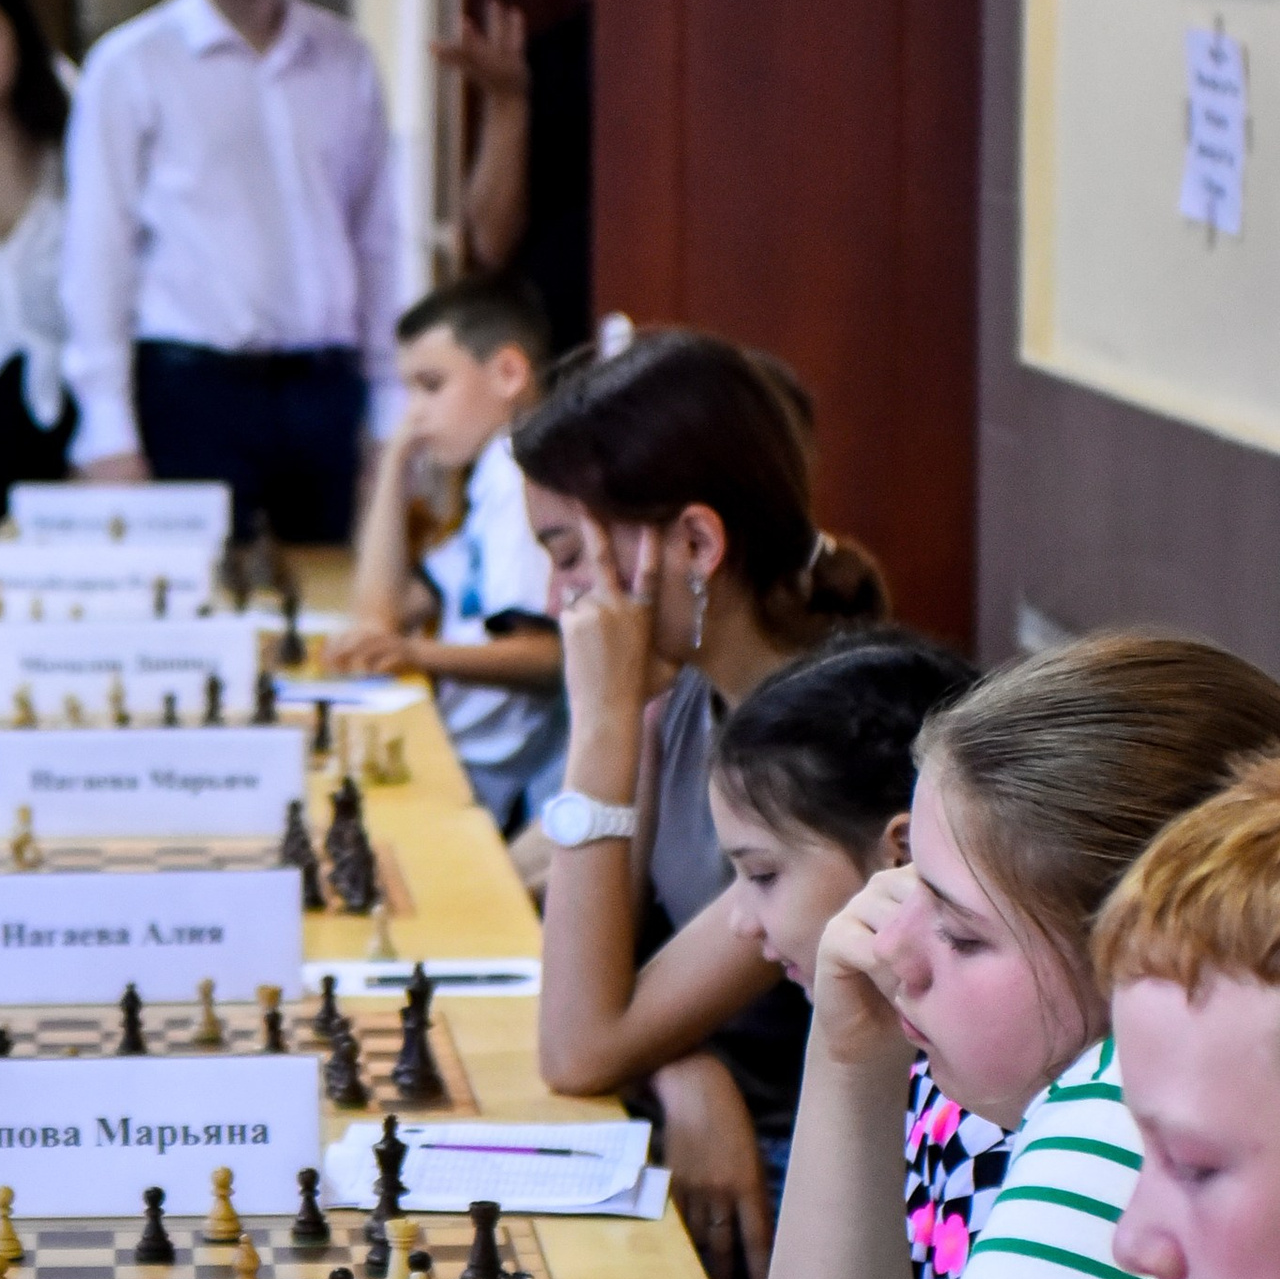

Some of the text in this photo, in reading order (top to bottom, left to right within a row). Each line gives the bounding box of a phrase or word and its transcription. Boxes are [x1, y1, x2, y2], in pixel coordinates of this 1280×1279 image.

[1, 922, 225, 948] Нагаева Алия
[95, 1117, 270, 1155] Марьяна
